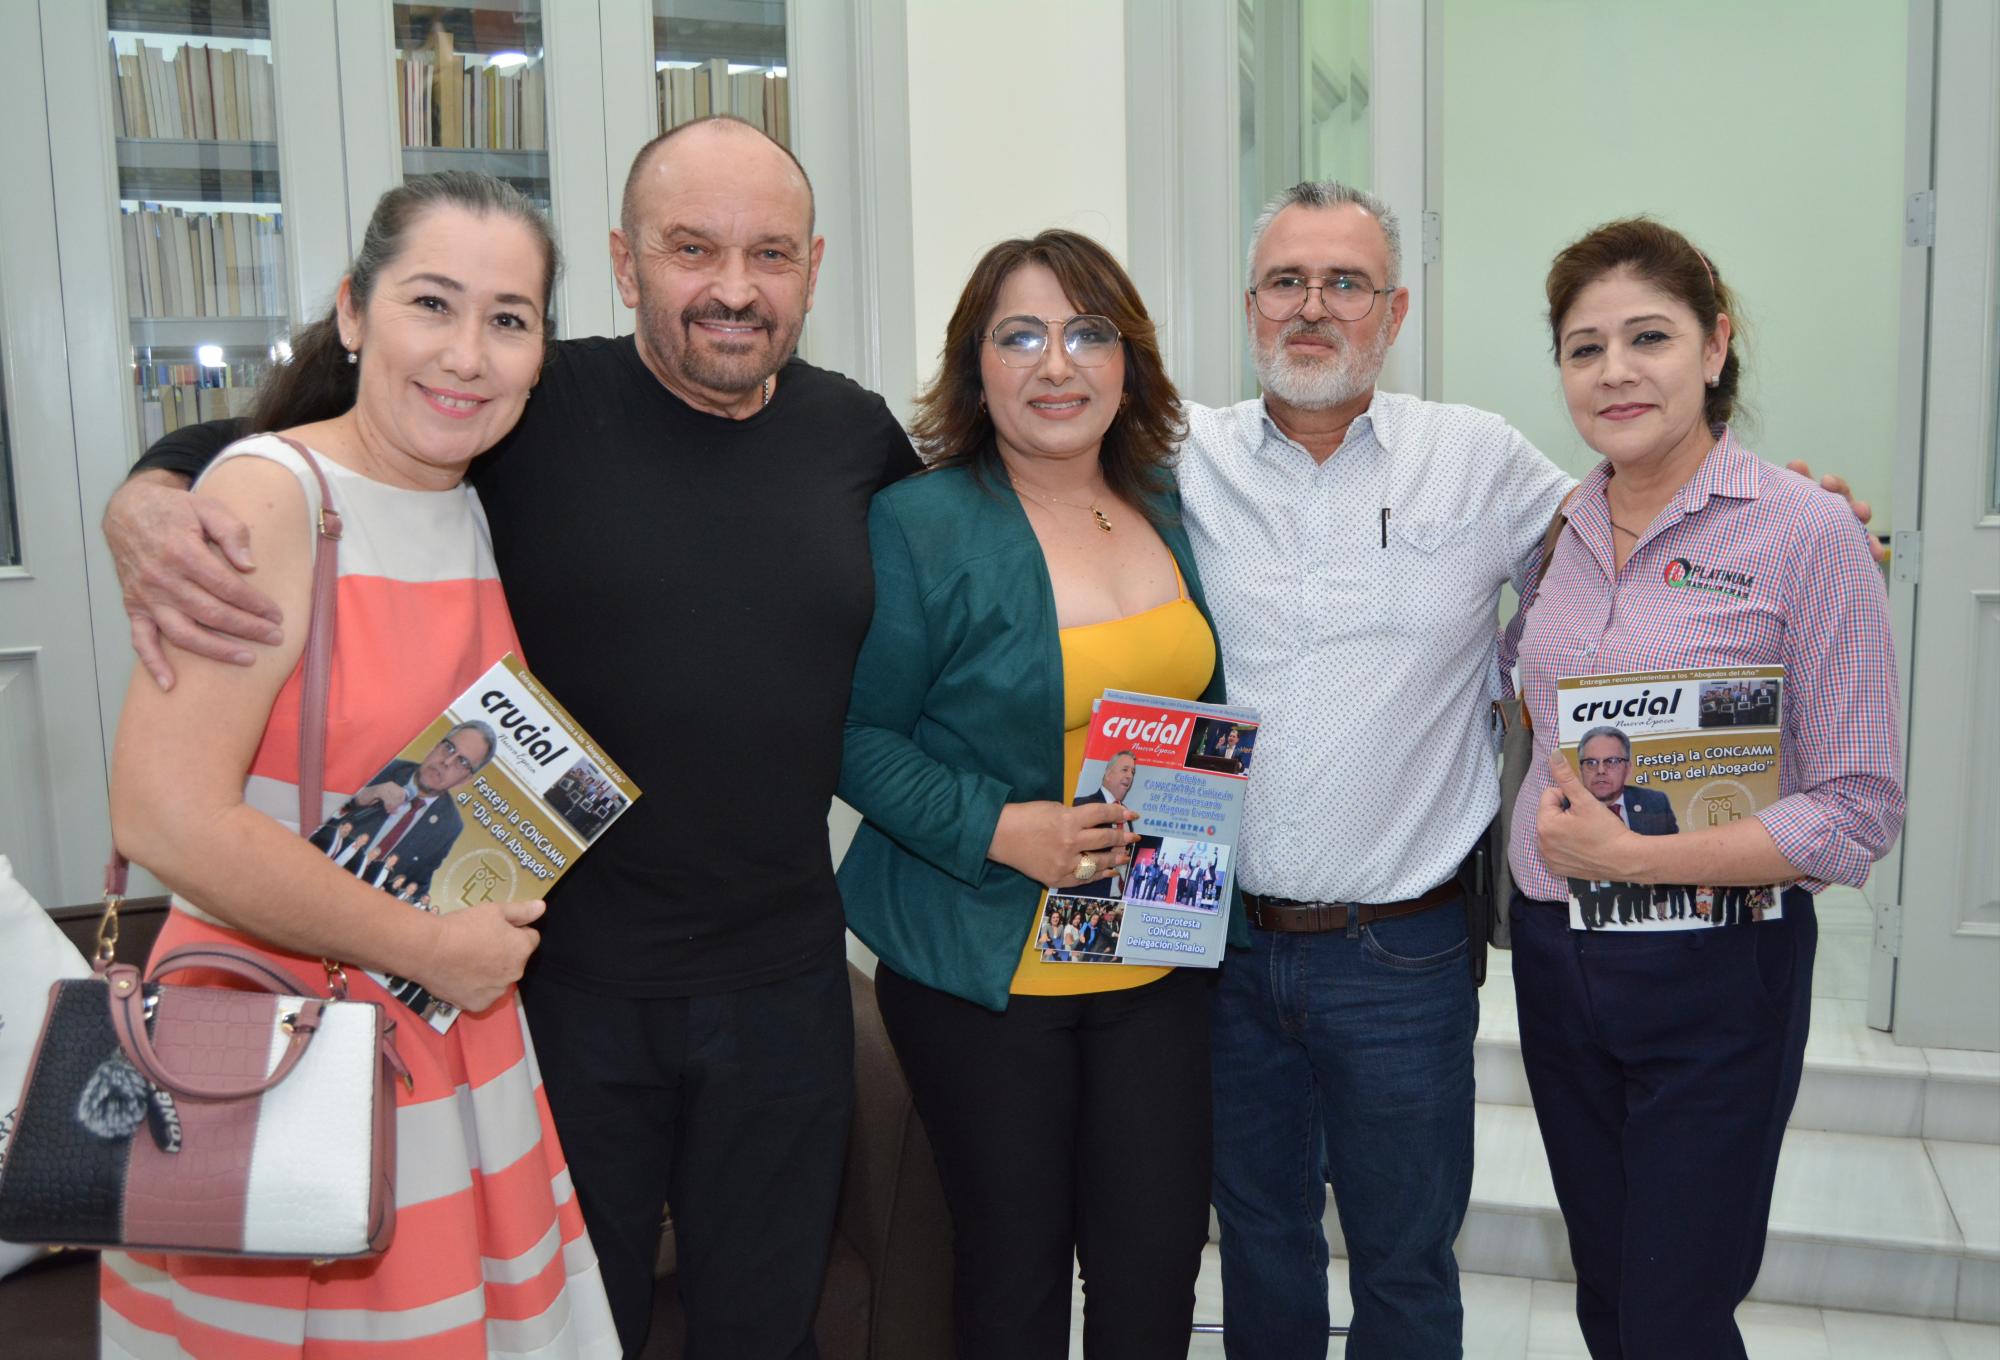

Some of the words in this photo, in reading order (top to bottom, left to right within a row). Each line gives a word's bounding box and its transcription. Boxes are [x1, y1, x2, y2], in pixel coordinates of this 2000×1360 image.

[1691, 565, 1755, 587] PLATINUM
[1611, 674, 1670, 684] reconocimientos
[1572, 688, 1682, 722] crucial
[480, 690, 568, 767] crucial
[1102, 714, 1190, 746] crucial
[1636, 751, 1685, 766] Festeja
[1689, 750, 1700, 761] la
[1704, 745, 1773, 759] CONCAMM
[1635, 772, 1648, 784] el
[1685, 766, 1706, 778] del
[457, 792, 472, 805] el
[491, 824, 511, 842] del
[473, 776, 509, 815] Festeja
[508, 809, 520, 825] la
[519, 820, 568, 869] CONCAMM
[1143, 818, 1205, 833] CANACINTRA
[1142, 913, 1163, 925] Toma
[1165, 917, 1201, 929] protesta
[1148, 926, 1190, 940] CONCAAM
[1127, 937, 1173, 949] Delegación
[1175, 941, 1205, 954] Sinaloa
